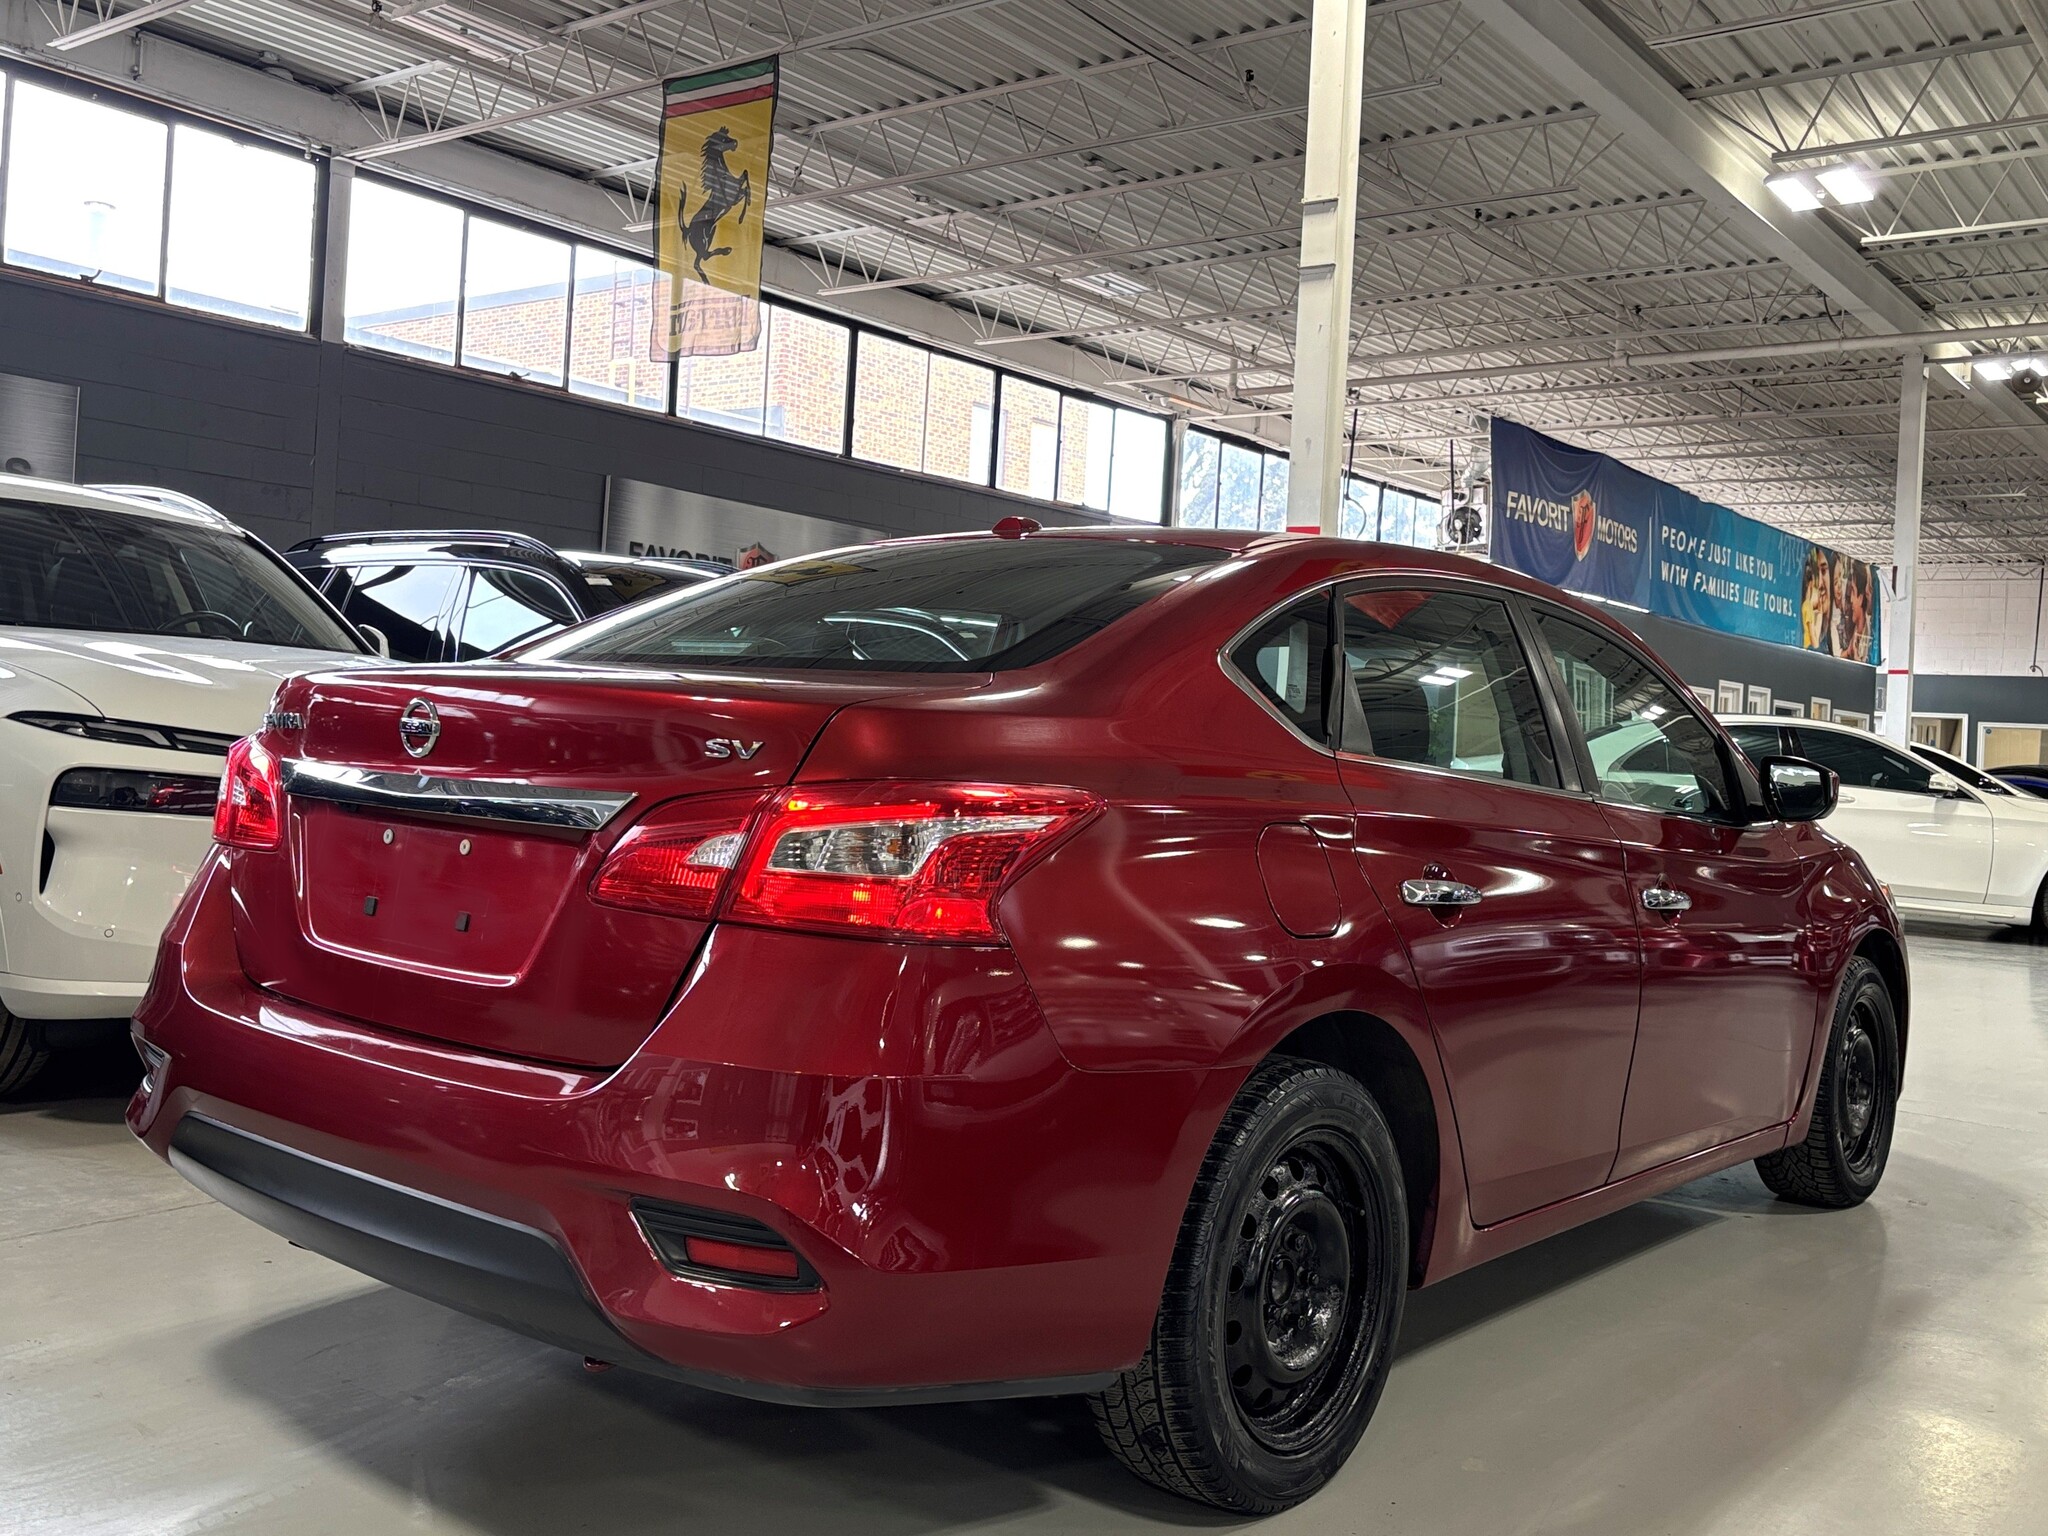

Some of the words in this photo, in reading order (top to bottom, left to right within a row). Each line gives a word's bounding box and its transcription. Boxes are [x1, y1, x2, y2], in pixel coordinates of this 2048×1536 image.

[1506, 490, 1570, 532] FAVORIT
[1597, 515, 1638, 554] MOTORS
[1708, 542, 1731, 567] JUST
[1735, 551, 1754, 574] LIKE
[1756, 558, 1776, 584] YOU,
[1661, 560, 1689, 588] WITH
[1693, 571, 1740, 603] FAMILIES
[1743, 586, 1760, 609] LIKE
[1763, 592, 1797, 618] YOURS.
[704, 738, 764, 759] SV
